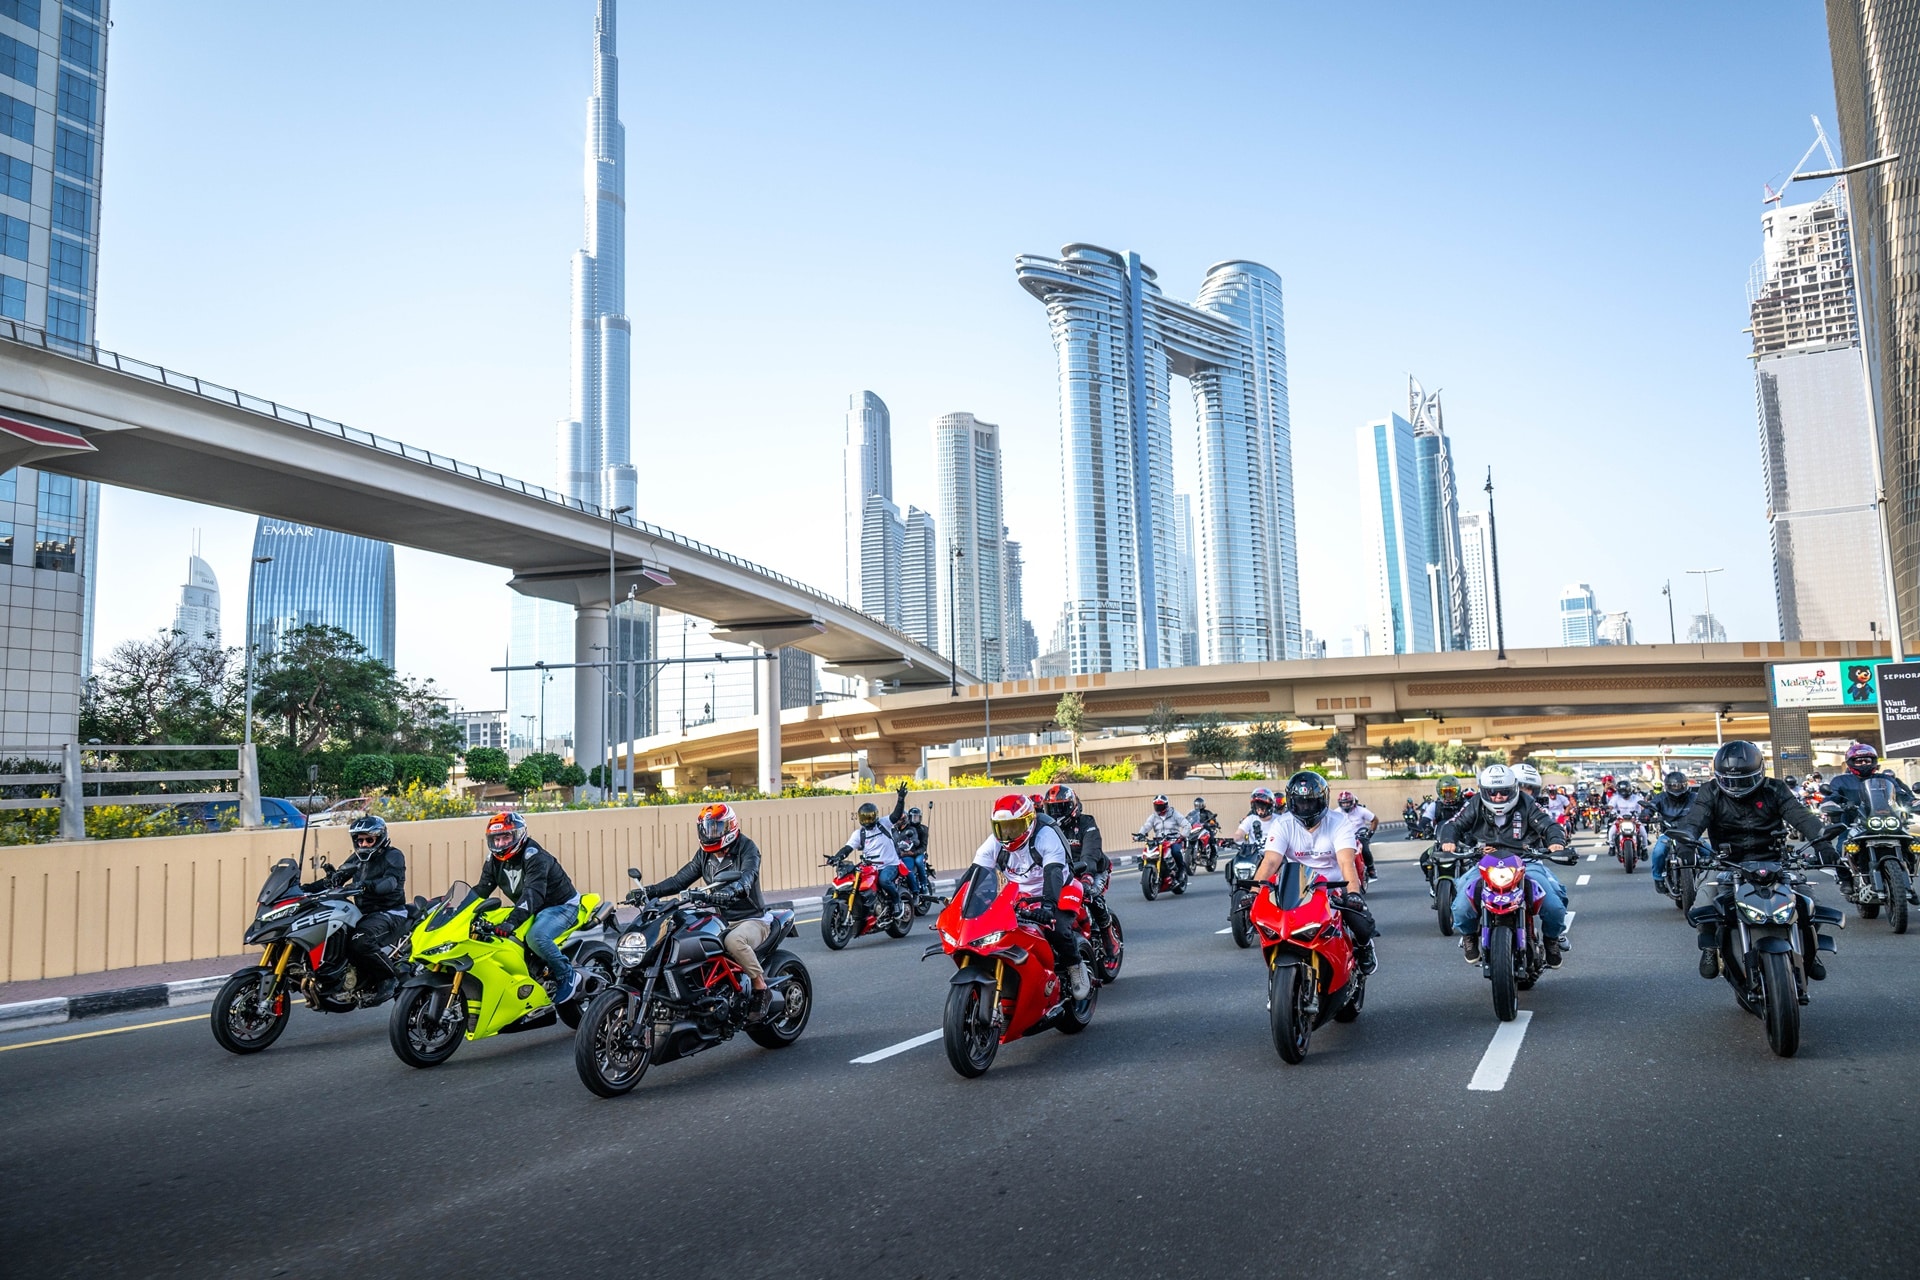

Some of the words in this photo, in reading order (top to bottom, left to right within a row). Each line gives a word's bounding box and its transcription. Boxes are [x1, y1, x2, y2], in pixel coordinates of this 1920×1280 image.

[262, 525, 314, 537] EMAAR
[1884, 699, 1906, 707] Want
[1885, 706, 1899, 714] the
[1900, 705, 1918, 713] Best
[1886, 713, 1896, 721] in
